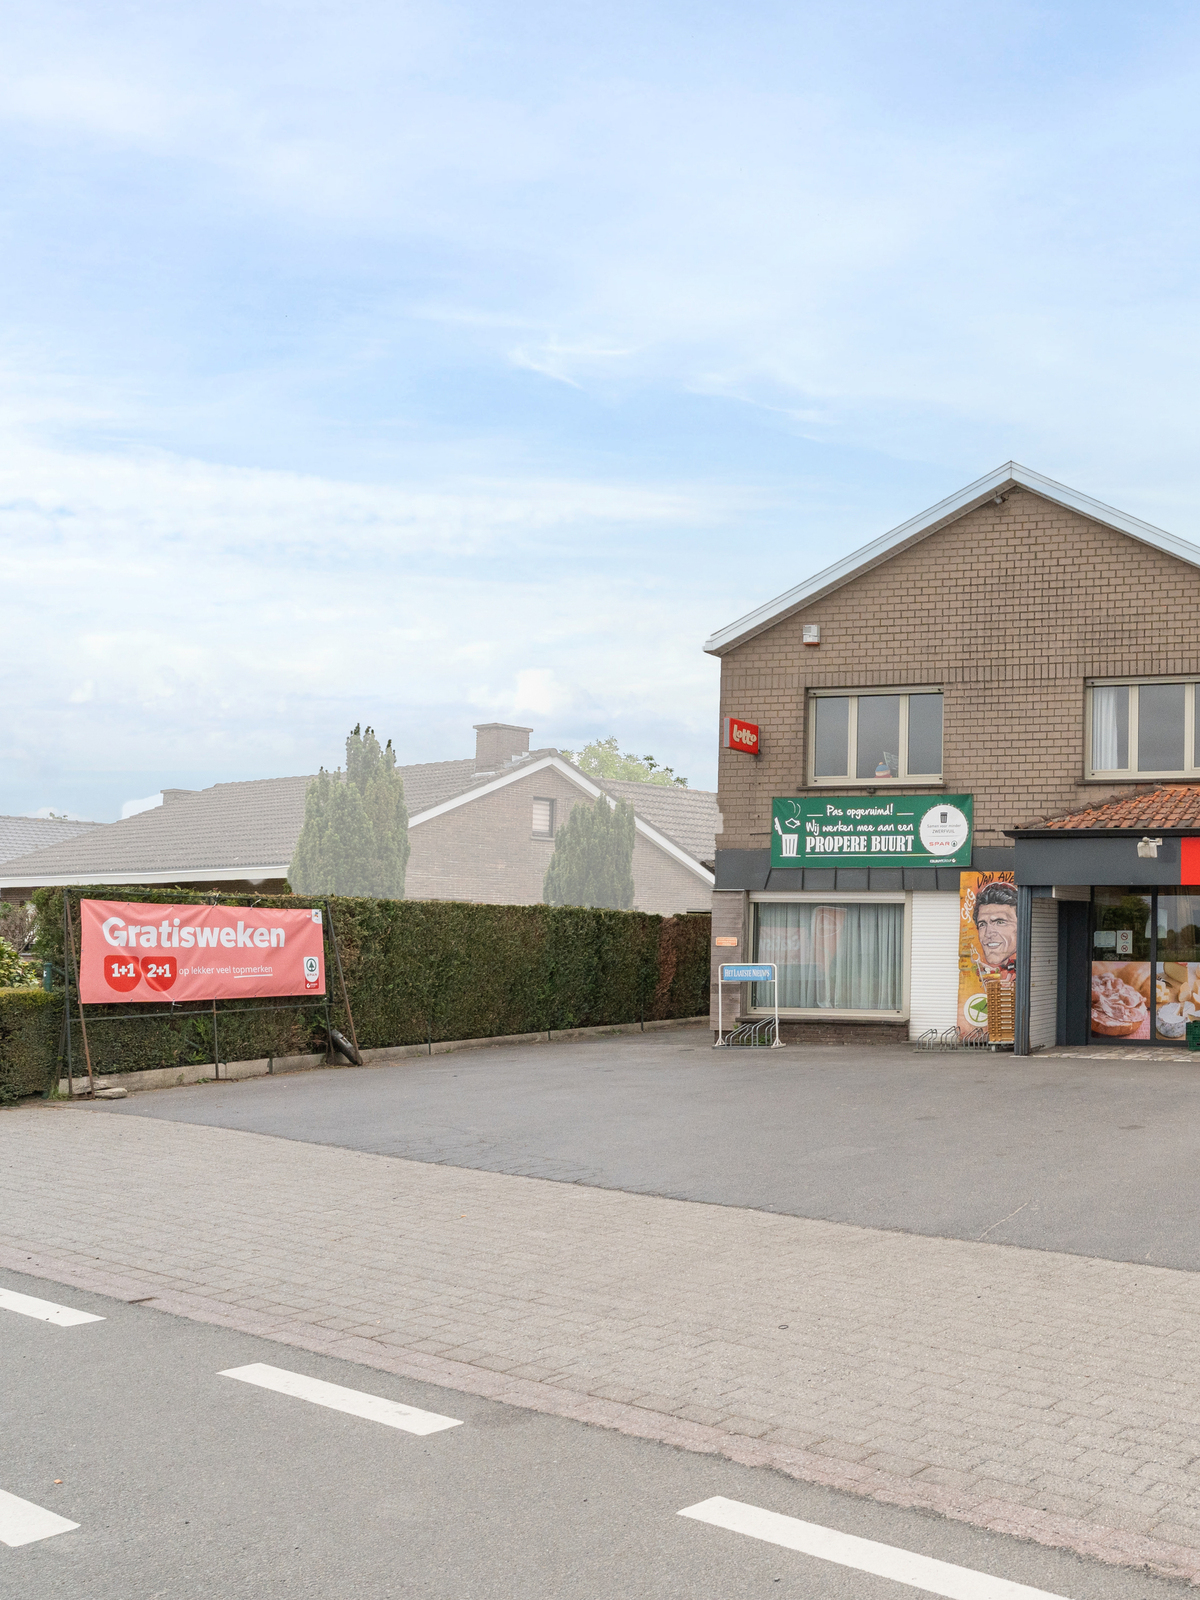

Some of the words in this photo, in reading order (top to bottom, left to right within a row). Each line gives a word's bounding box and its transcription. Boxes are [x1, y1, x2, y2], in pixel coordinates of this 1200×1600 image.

[732, 725, 757, 746] Lotto
[826, 804, 843, 816] Pas
[846, 803, 894, 819] opgeruimd!
[806, 819, 820, 835] Wij
[822, 820, 853, 831] werken
[805, 836, 867, 852] PROPERE
[871, 836, 914, 852] BUURT
[961, 888, 976, 923] GREG
[102, 916, 285, 947] Gratisweken
[112, 963, 135, 977] 1+1
[147, 964, 171, 977] 2+1
[179, 968, 189, 976] op
[191, 966, 214, 974] lekker
[232, 965, 272, 975] topmerken
